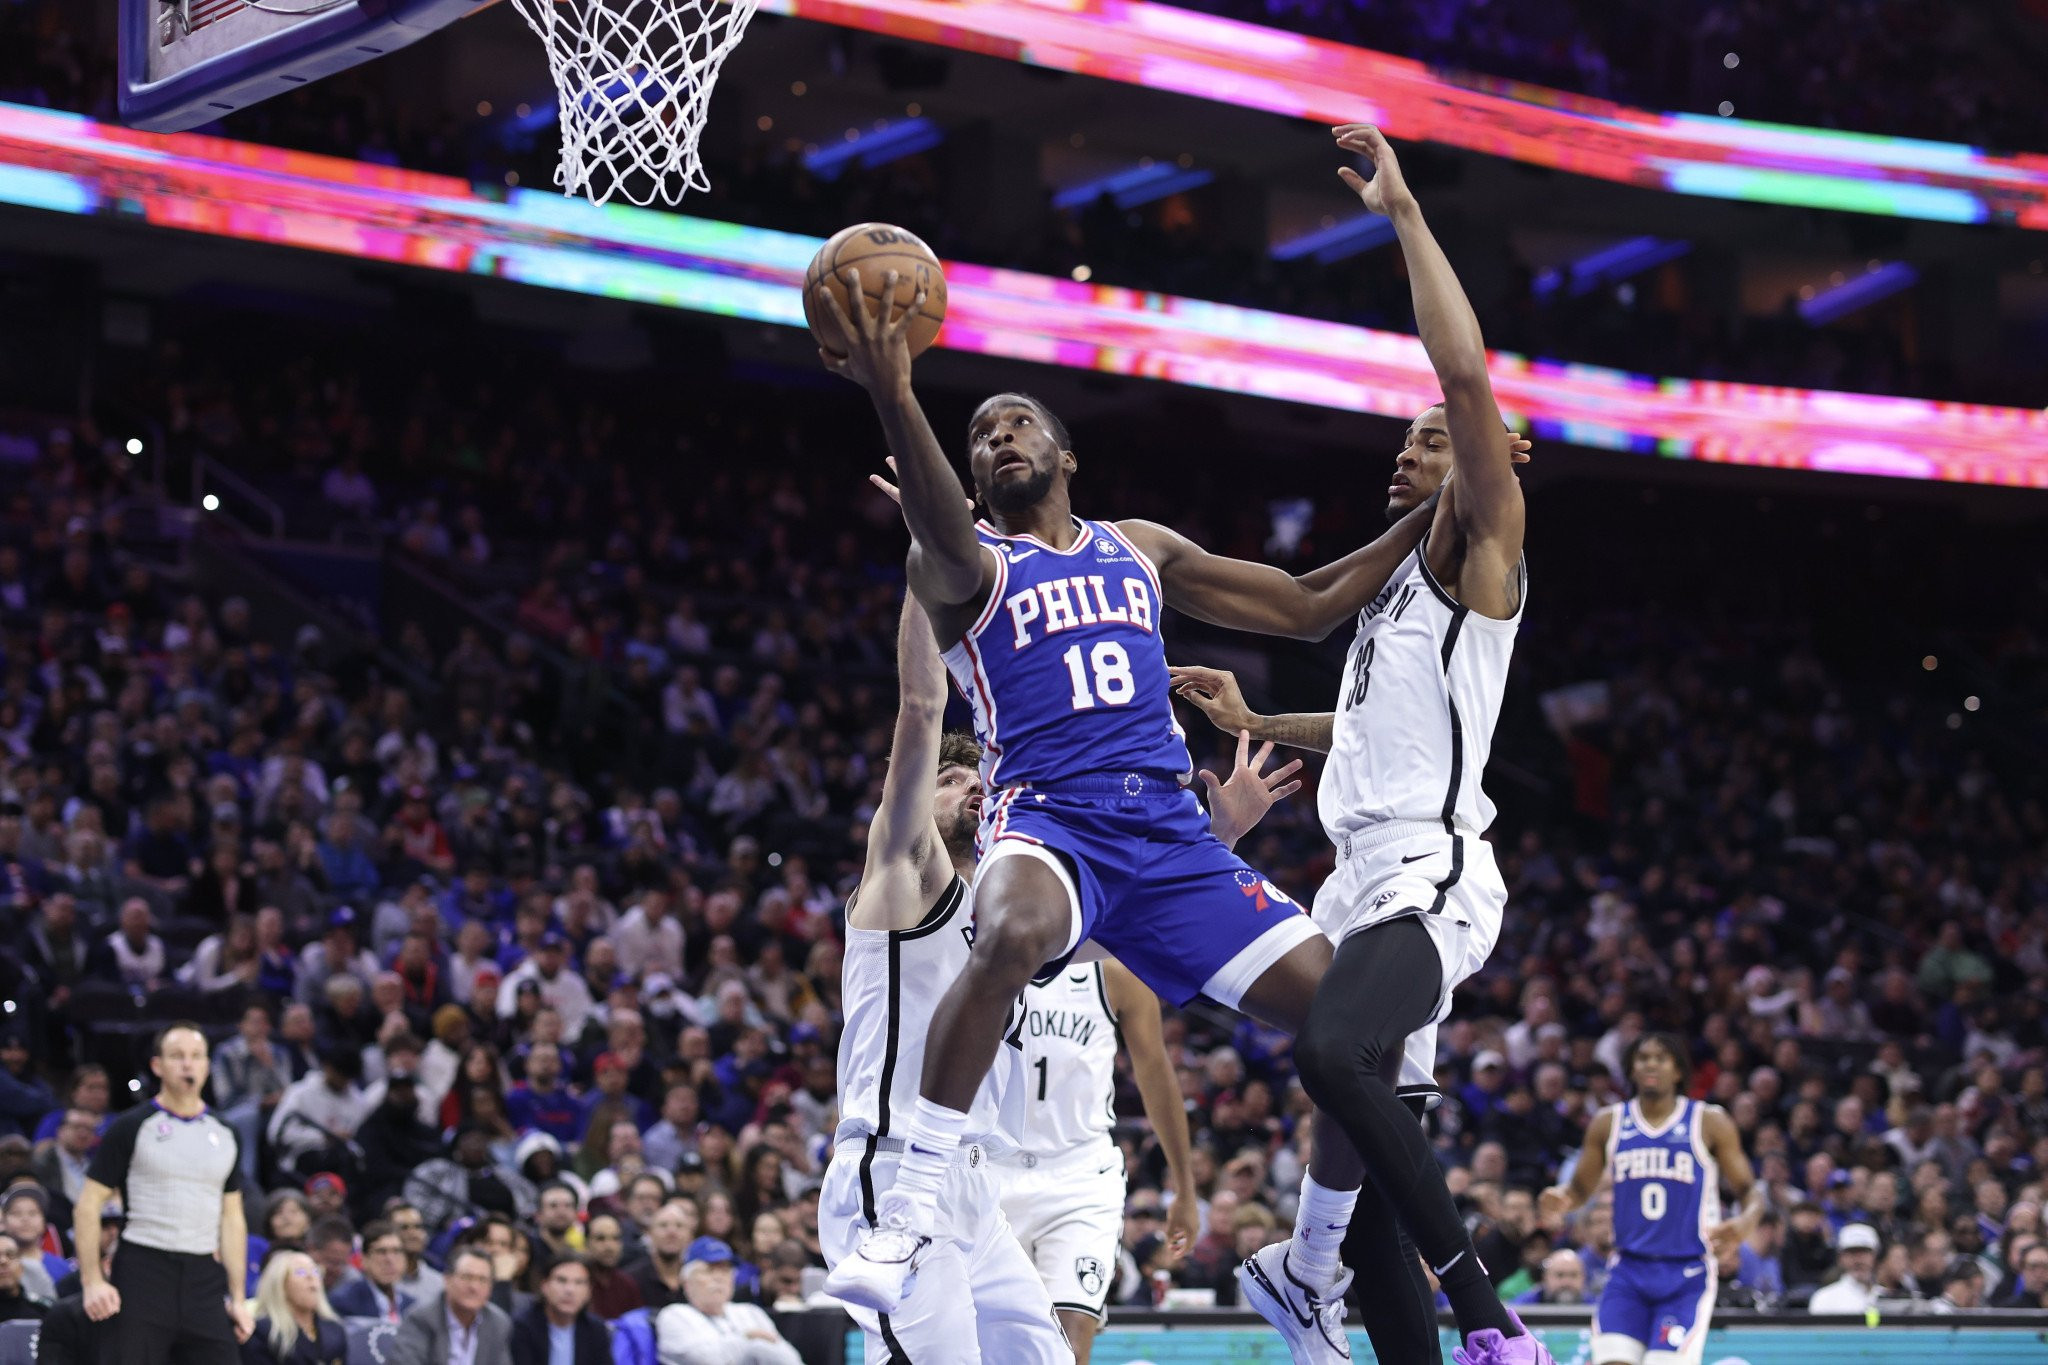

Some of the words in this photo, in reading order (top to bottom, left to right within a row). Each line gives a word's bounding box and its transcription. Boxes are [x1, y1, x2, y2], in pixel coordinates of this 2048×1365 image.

[1096, 556, 1134, 564] crypto.com
[1006, 575, 1153, 651] PHILA
[1063, 641, 1136, 711] 18
[1345, 637, 1376, 712] 33
[1029, 1009, 1096, 1046] OKLYN
[1033, 1056, 1048, 1102] 1
[1615, 1147, 1695, 1184] PHILA
[1641, 1183, 1667, 1221] 0
